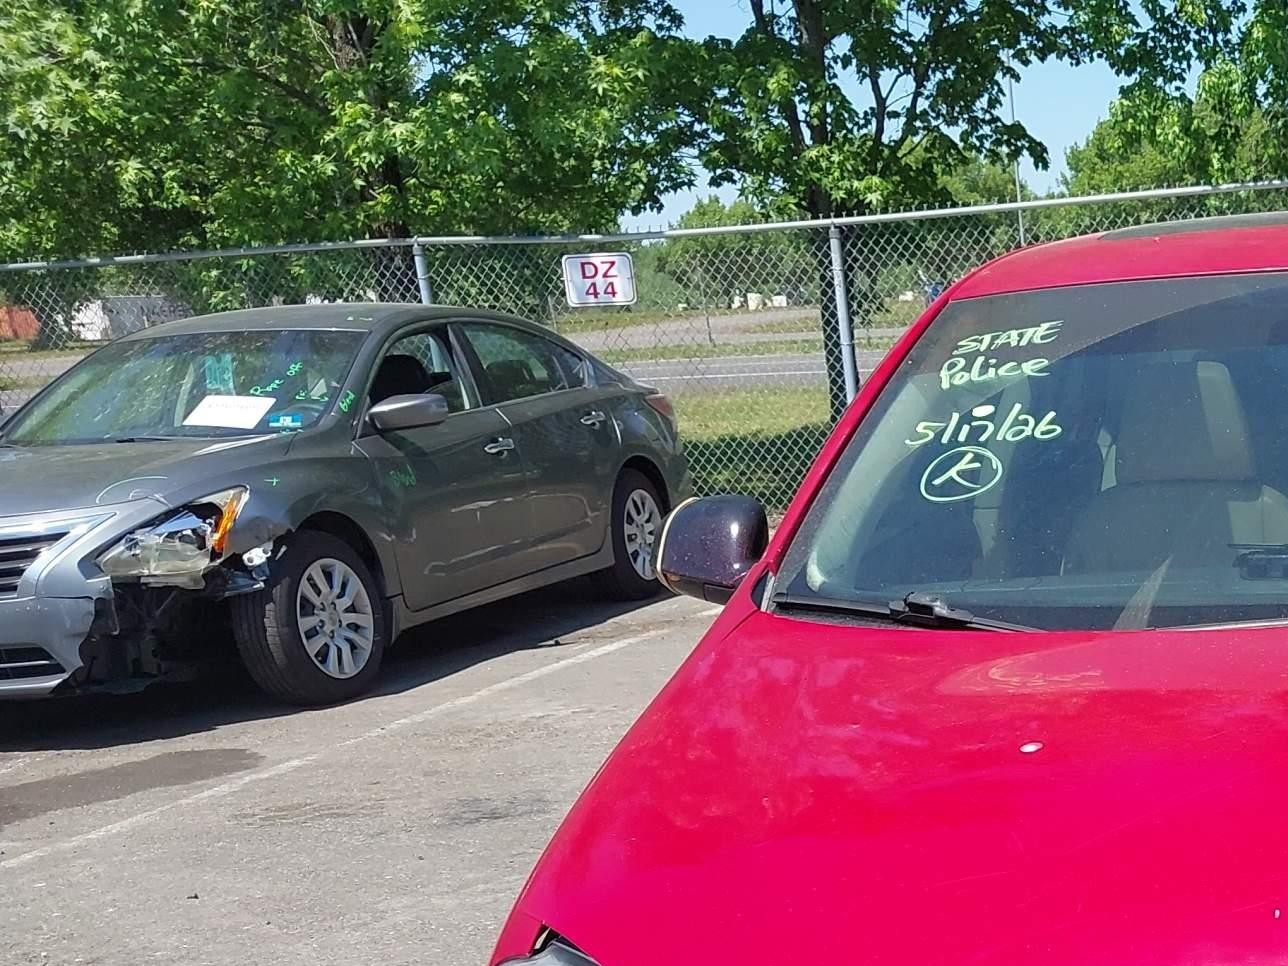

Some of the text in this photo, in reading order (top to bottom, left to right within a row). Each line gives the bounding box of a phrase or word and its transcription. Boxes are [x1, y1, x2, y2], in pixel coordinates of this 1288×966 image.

[580, 261, 618, 279] DZ
[585, 281, 618, 299] 44
[952, 320, 1064, 355] STATE
[904, 402, 1063, 445] 5/17/26
